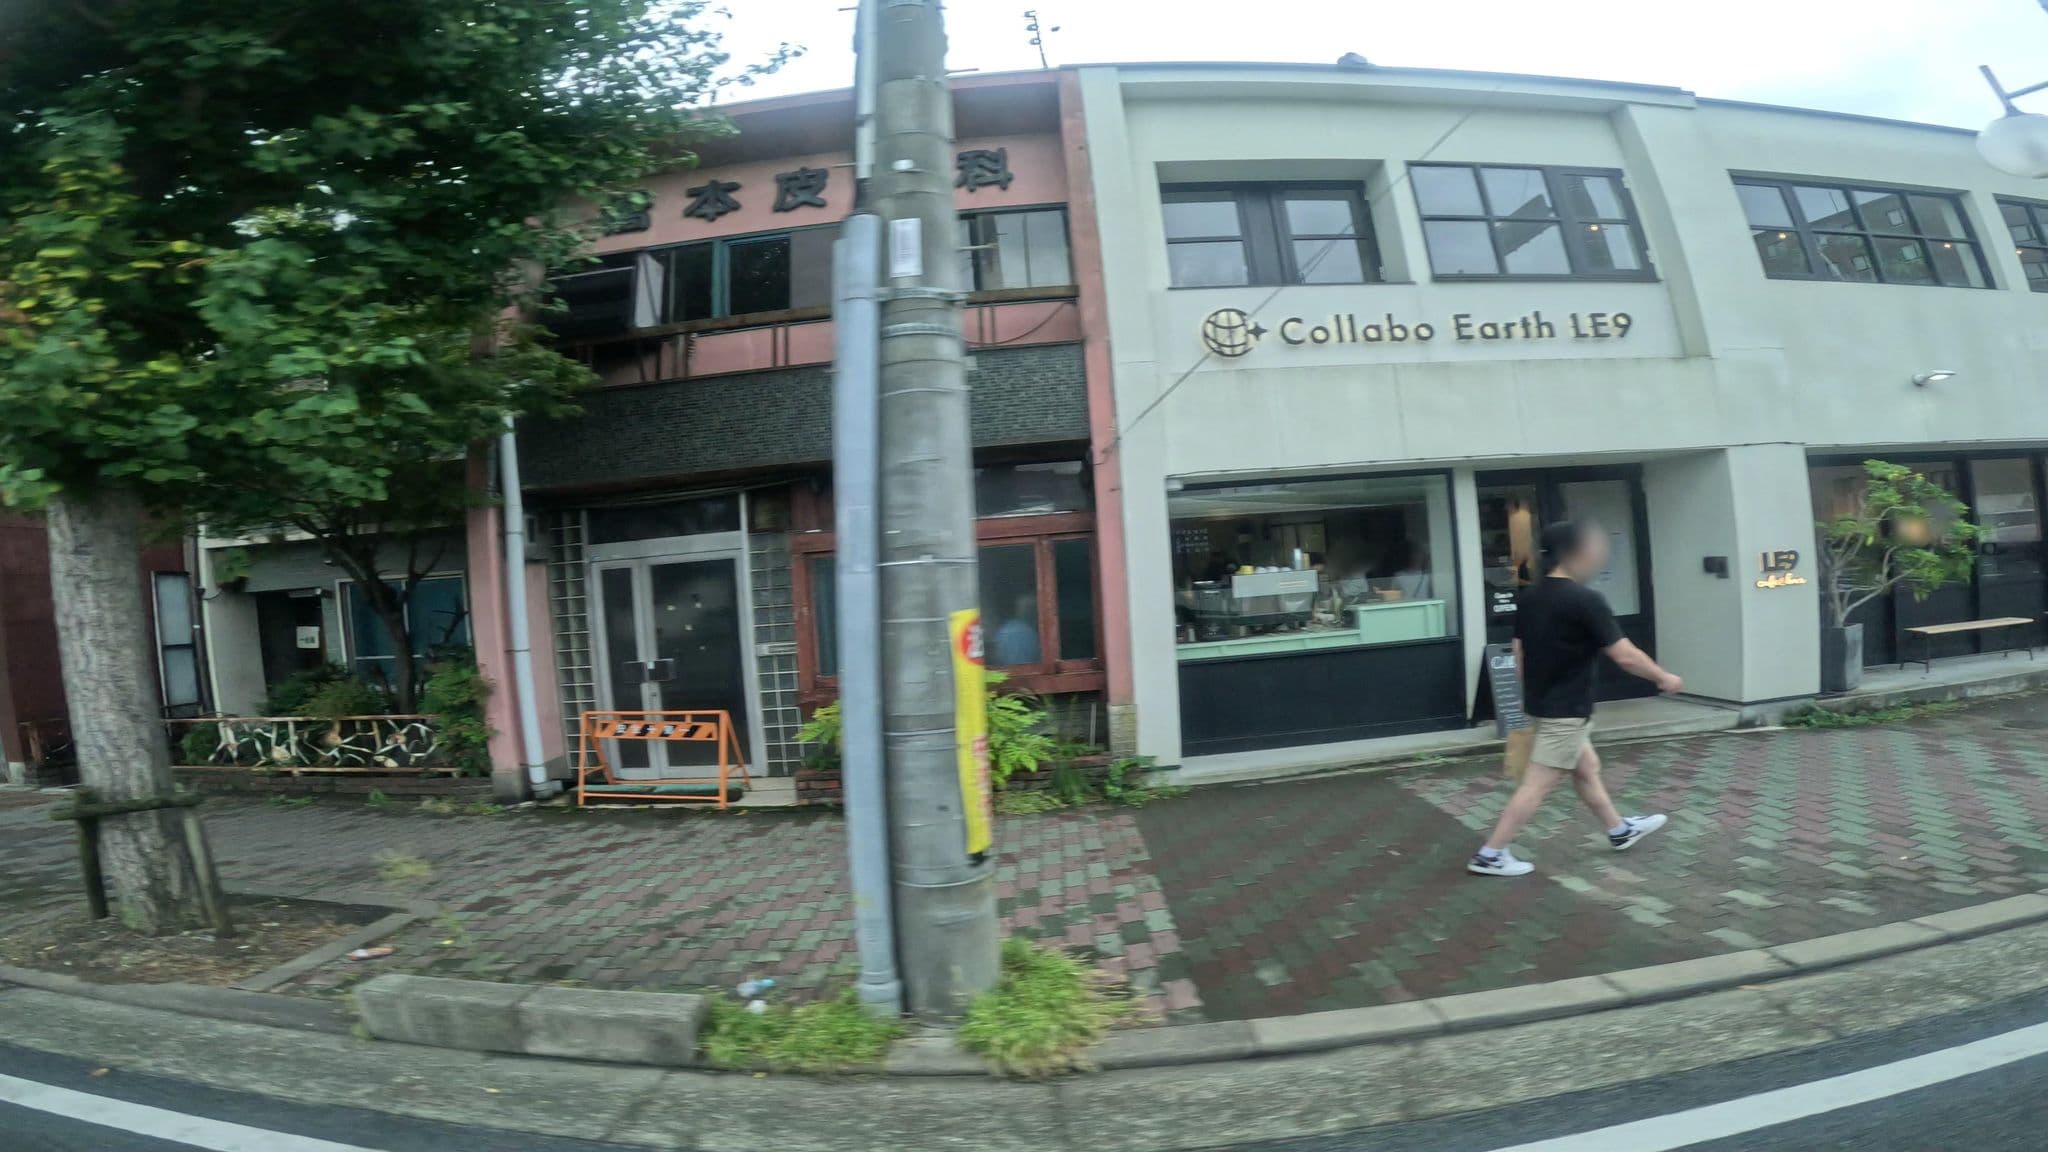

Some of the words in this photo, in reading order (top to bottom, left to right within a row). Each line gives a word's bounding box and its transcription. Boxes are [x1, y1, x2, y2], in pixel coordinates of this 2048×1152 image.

[1280, 313, 1435, 345] Collabo
[1452, 311, 1556, 341] Earth
[1569, 311, 1633, 340] LE9
[1760, 549, 1800, 573] LE9
